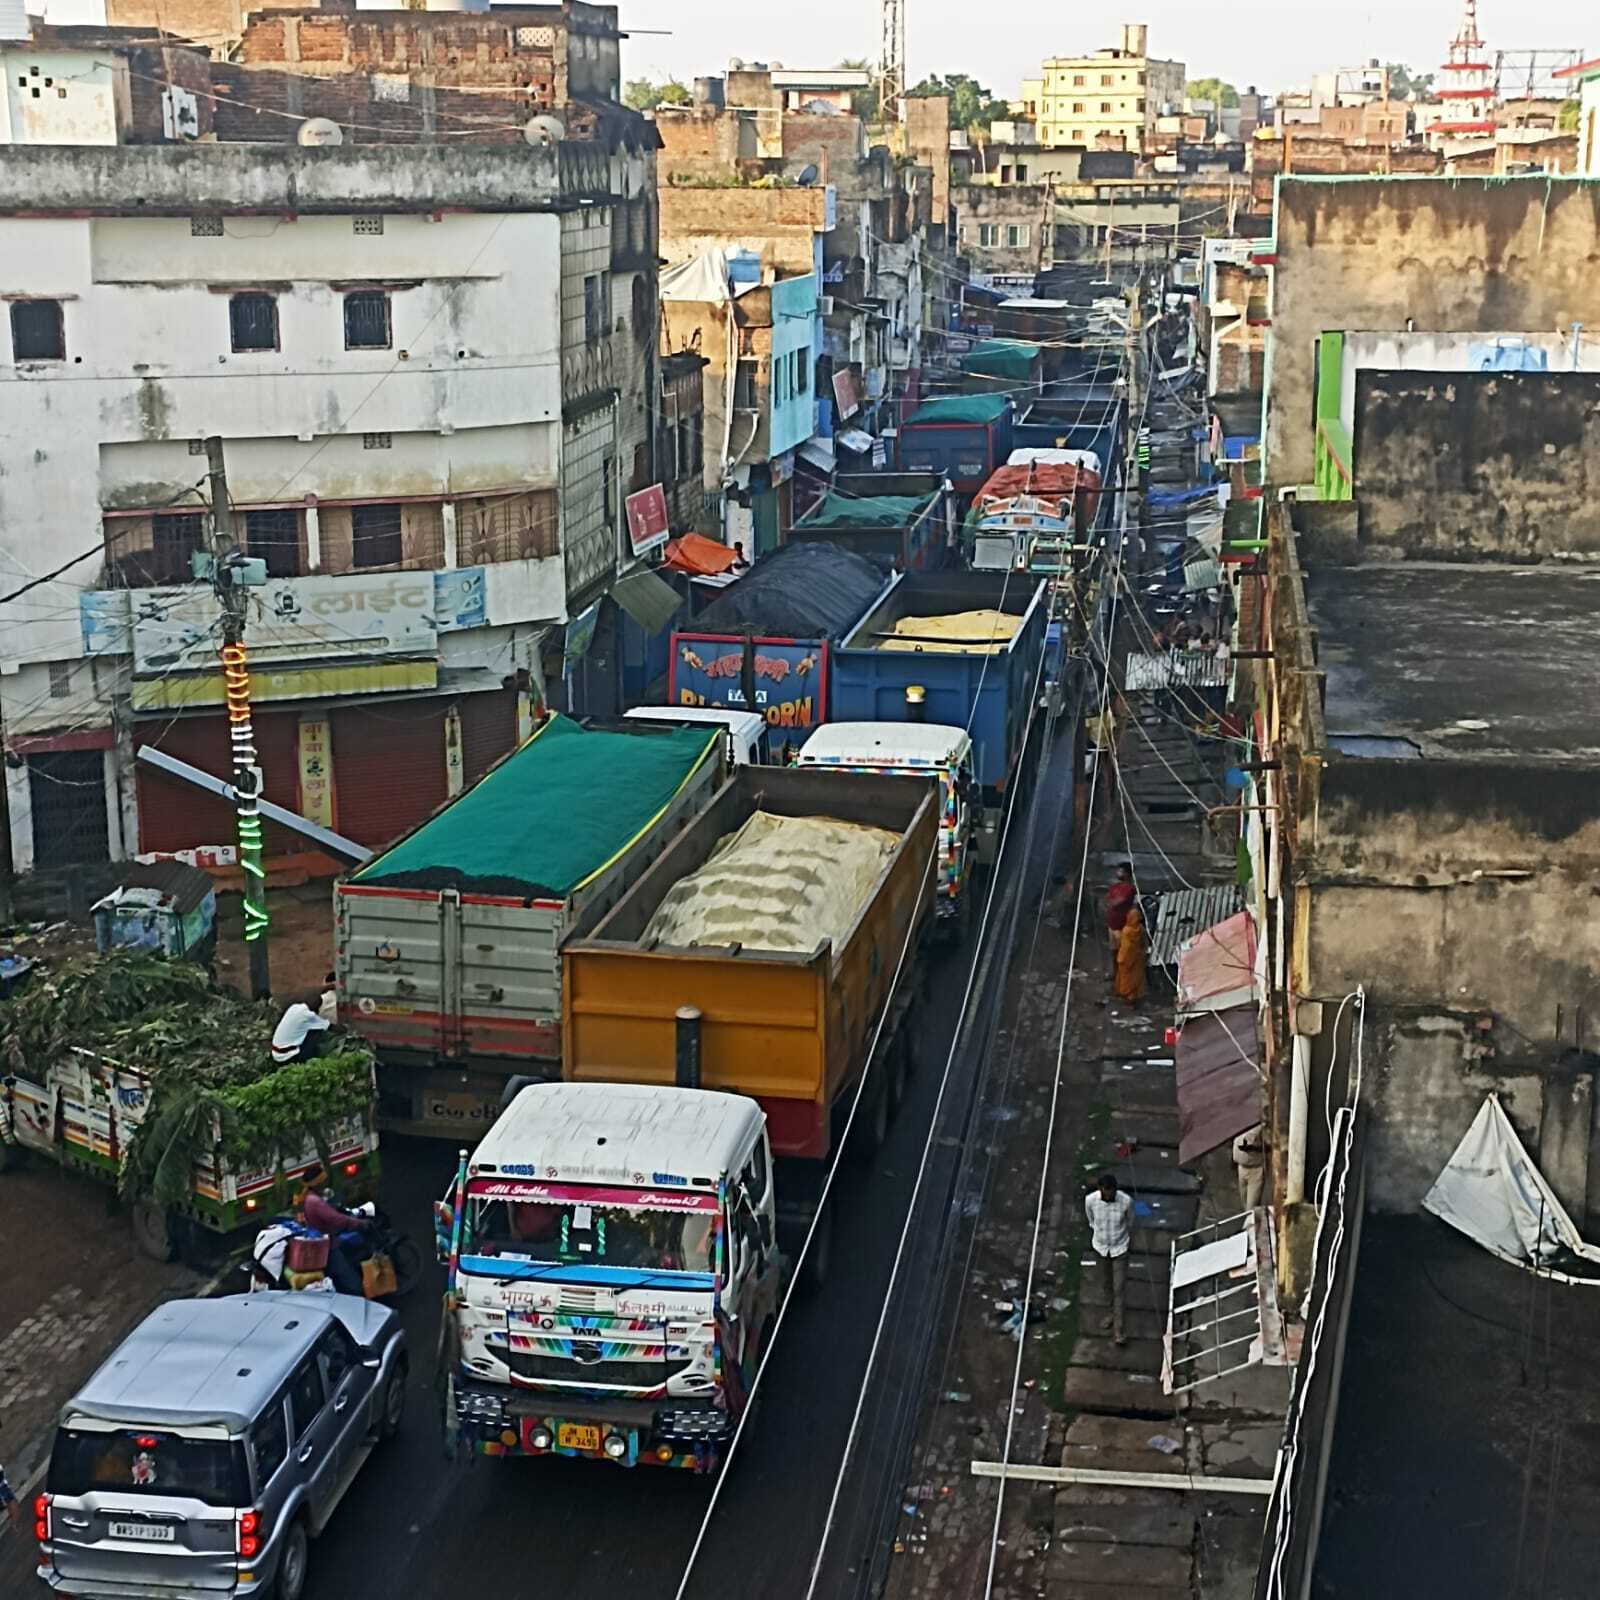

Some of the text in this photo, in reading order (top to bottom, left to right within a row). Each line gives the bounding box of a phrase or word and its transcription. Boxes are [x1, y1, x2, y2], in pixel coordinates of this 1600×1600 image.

[485, 1184, 510, 1195] All
[511, 1184, 550, 1196] India
[571, 1326, 602, 1337] TATA
